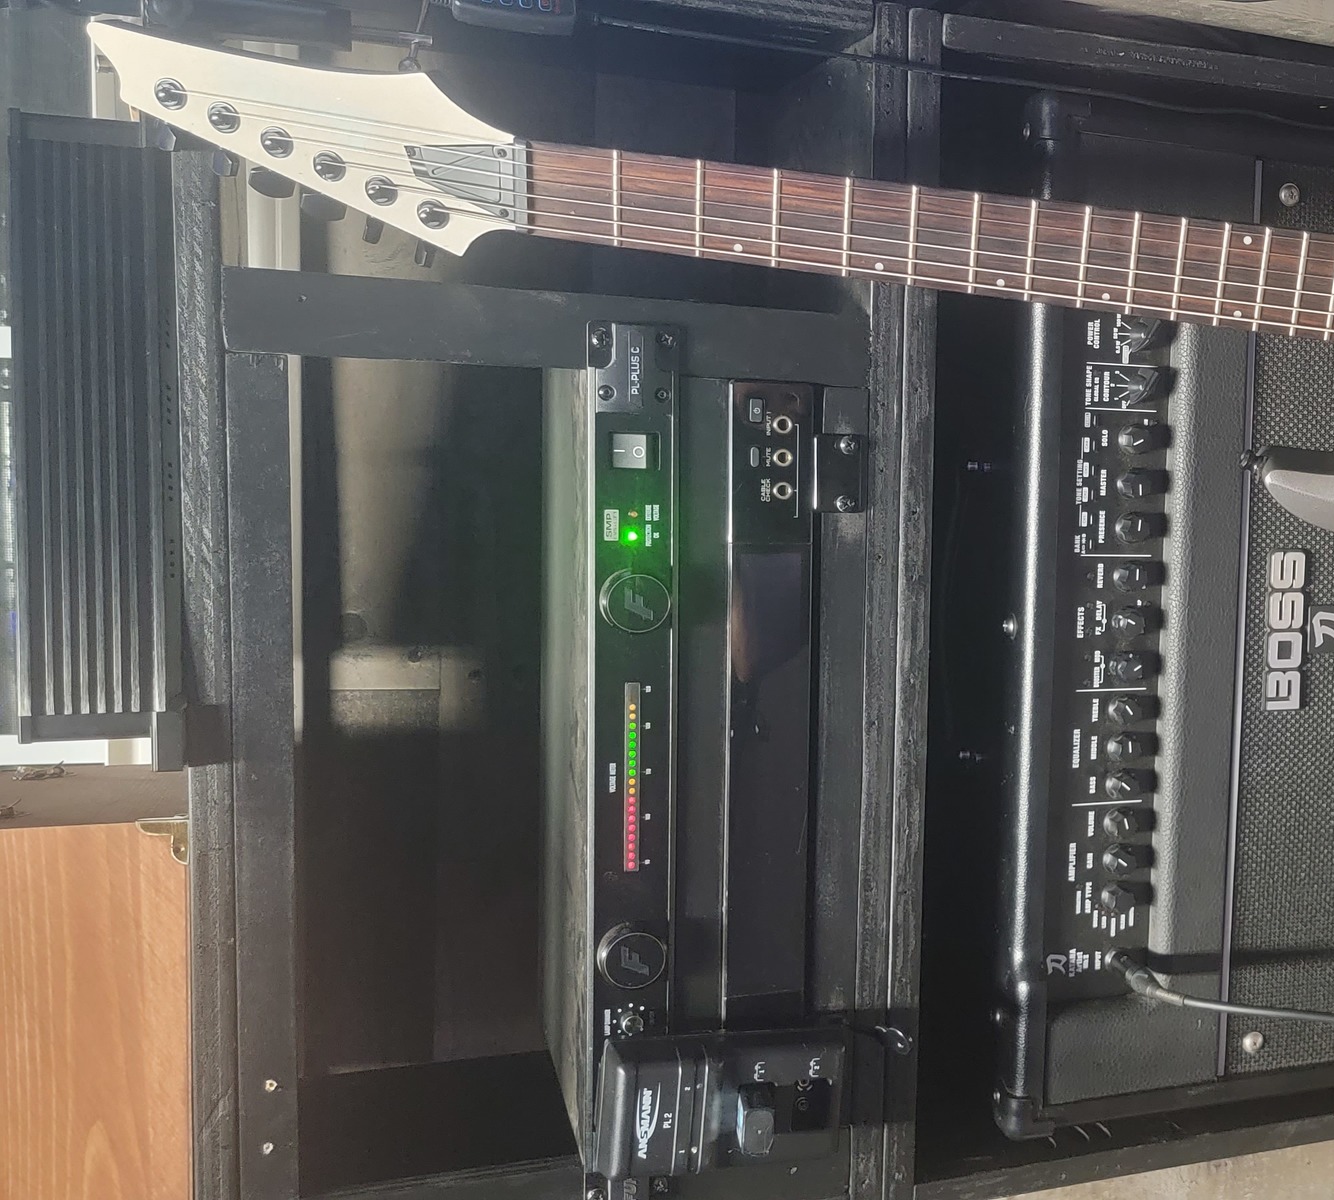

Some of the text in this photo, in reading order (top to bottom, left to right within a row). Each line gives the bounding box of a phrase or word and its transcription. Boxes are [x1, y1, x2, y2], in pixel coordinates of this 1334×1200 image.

[631, 356, 640, 394] PL-PLUS
[1098, 510, 1106, 543] PRESENCE
[1077, 606, 1085, 638] EFFECTS
[1095, 626, 1102, 635] FX
[1266, 551, 1306, 710] BOSS
[1092, 698, 1100, 722] TREBLE
[1072, 729, 1080, 768] EQUALIZER
[1090, 735, 1098, 760] MIDDLE
[1068, 842, 1077, 882] AMPLIFIER
[1086, 852, 1094, 869] GAIN
[1069, 948, 1077, 977] KATANA
[637, 1089, 652, 1159] ANSMANN
[663, 1119, 672, 1128] PL
